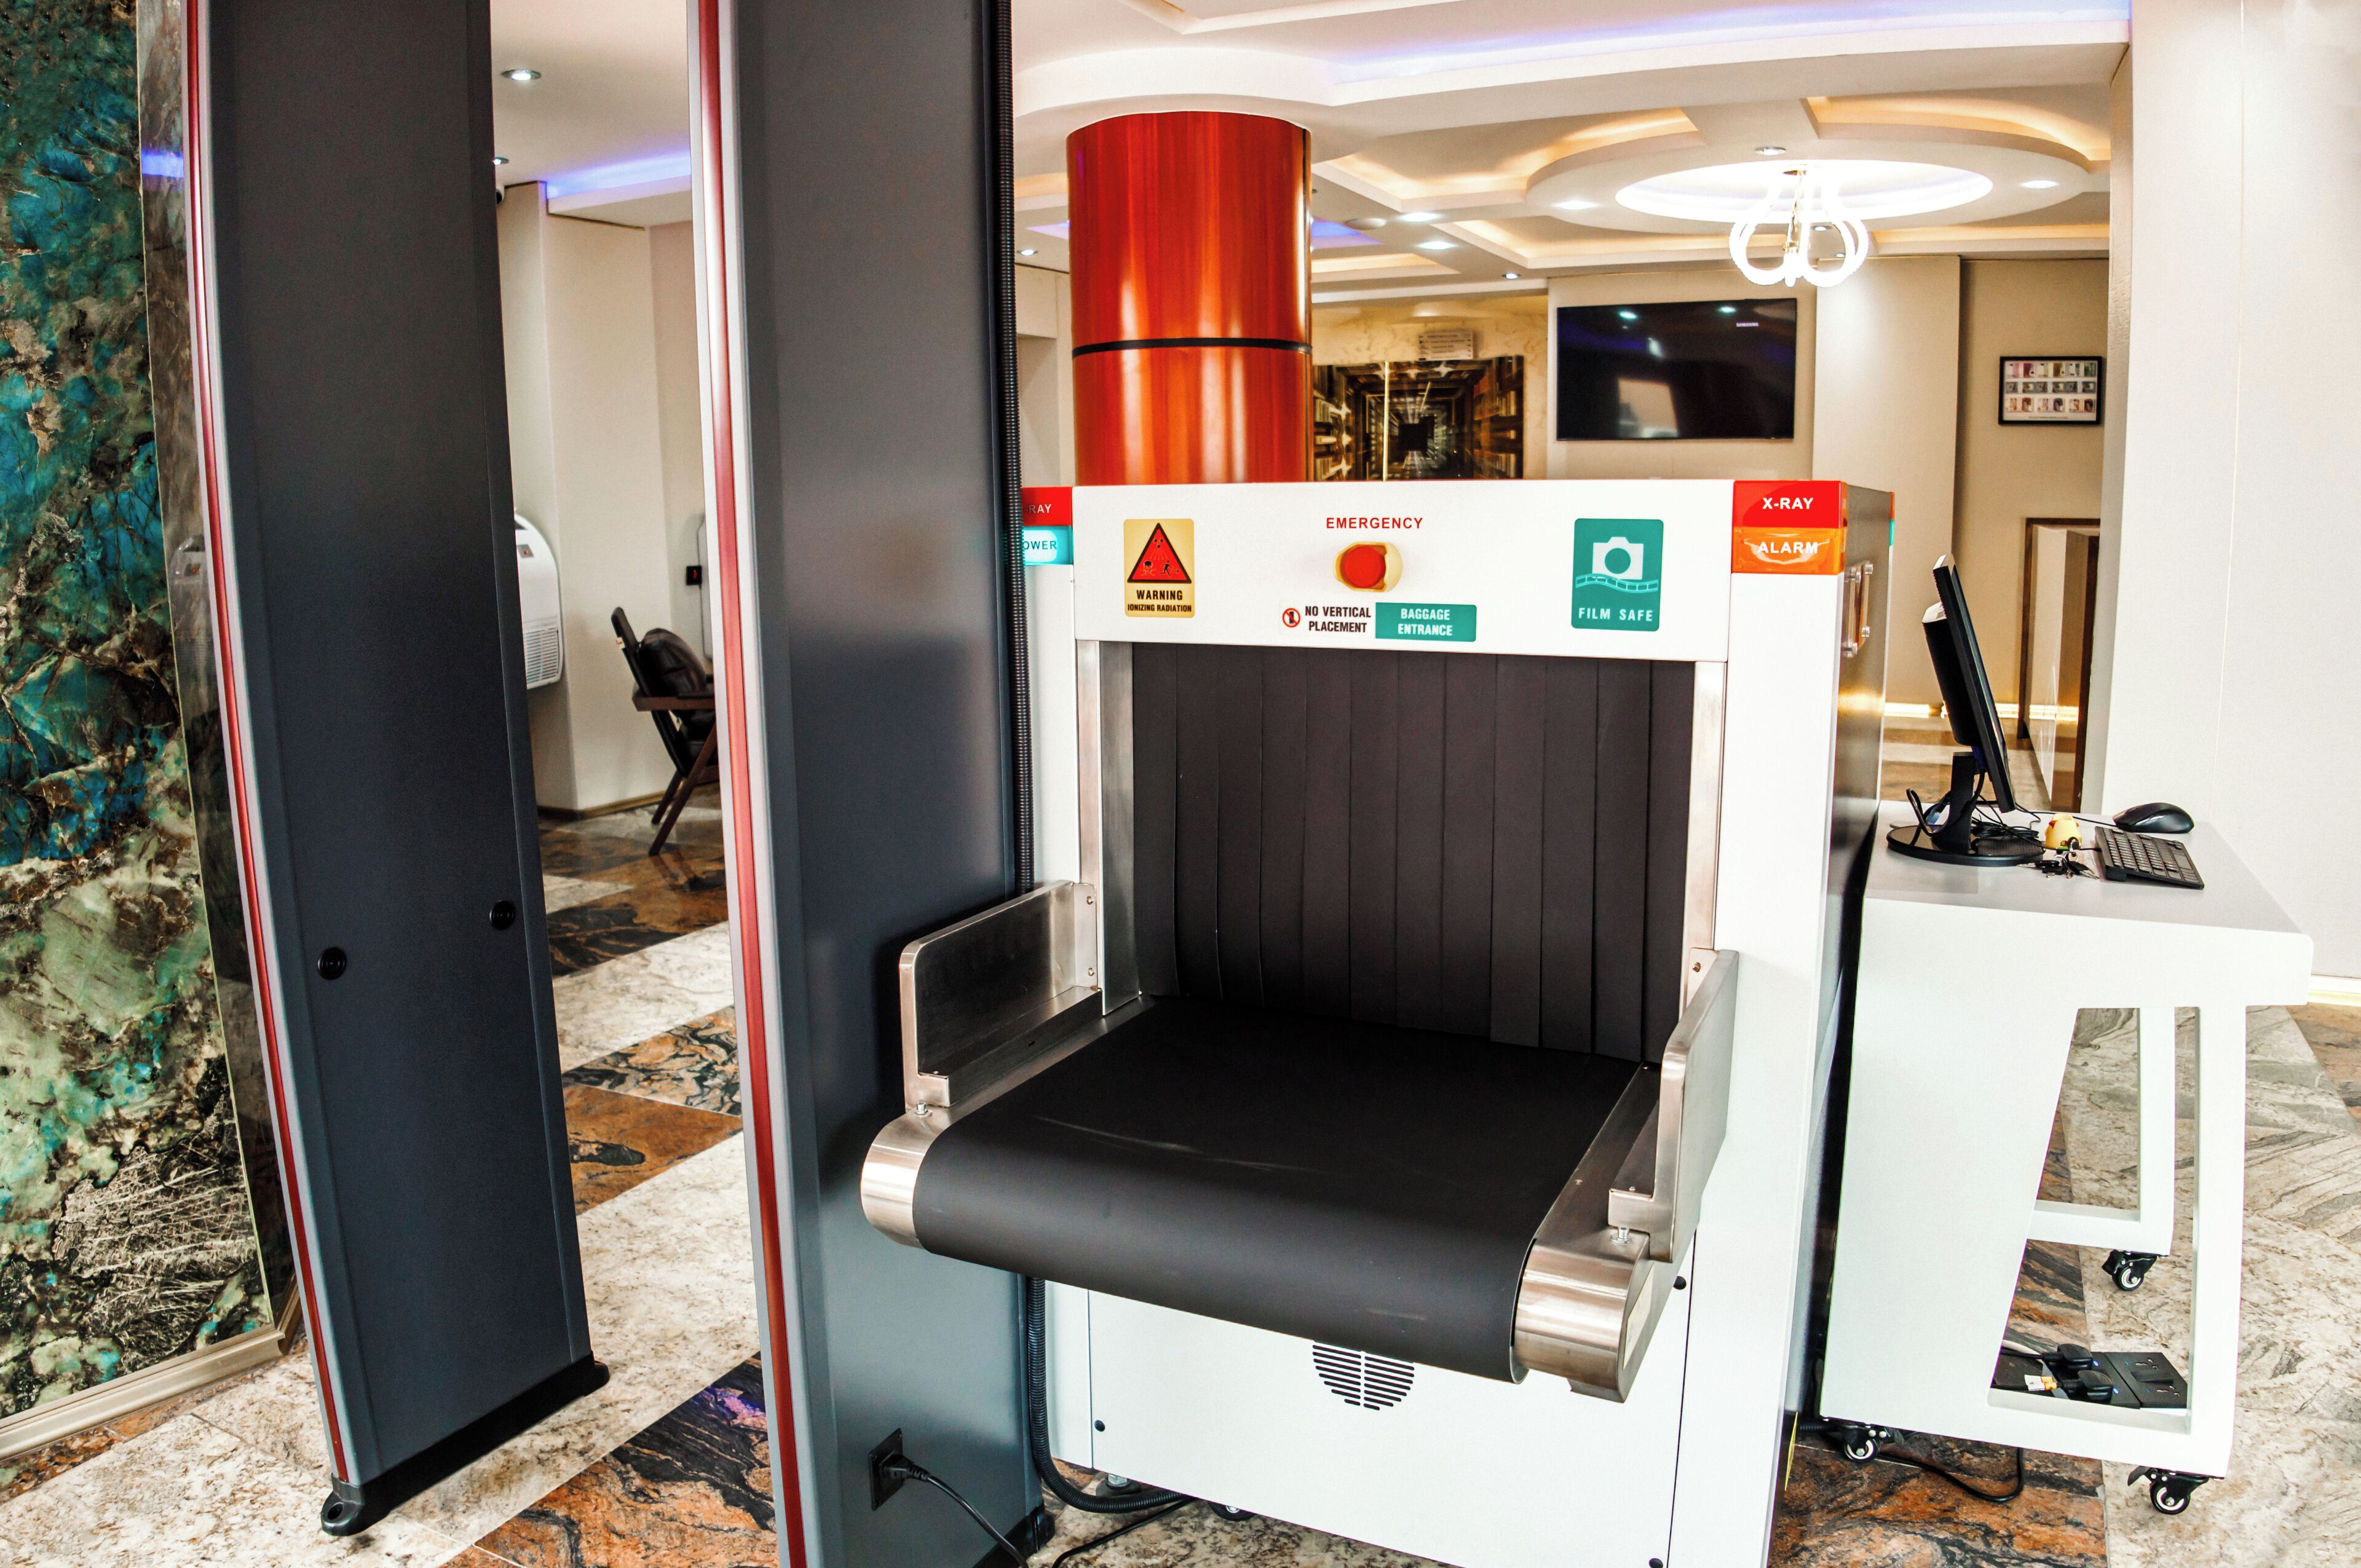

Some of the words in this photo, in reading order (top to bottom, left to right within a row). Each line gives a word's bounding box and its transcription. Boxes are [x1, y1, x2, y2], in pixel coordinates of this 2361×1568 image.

[1023, 503, 1052, 514] -RAY
[1762, 497, 1813, 510] X-RAY
[1326, 517, 1423, 529] EMERGENCY
[1023, 540, 1058, 550] OWER
[1758, 542, 1818, 554] ALARM
[1136, 589, 1183, 601] WARNING
[1305, 605, 1319, 617] NO
[1323, 606, 1371, 618] VERTICAL
[1401, 608, 1450, 620] BAGGAGE
[1578, 607, 1611, 620] FILM
[1619, 609, 1653, 622] SAFE
[1308, 621, 1367, 632] PLACEMENT
[1398, 623, 1453, 636] ENTRANCE
